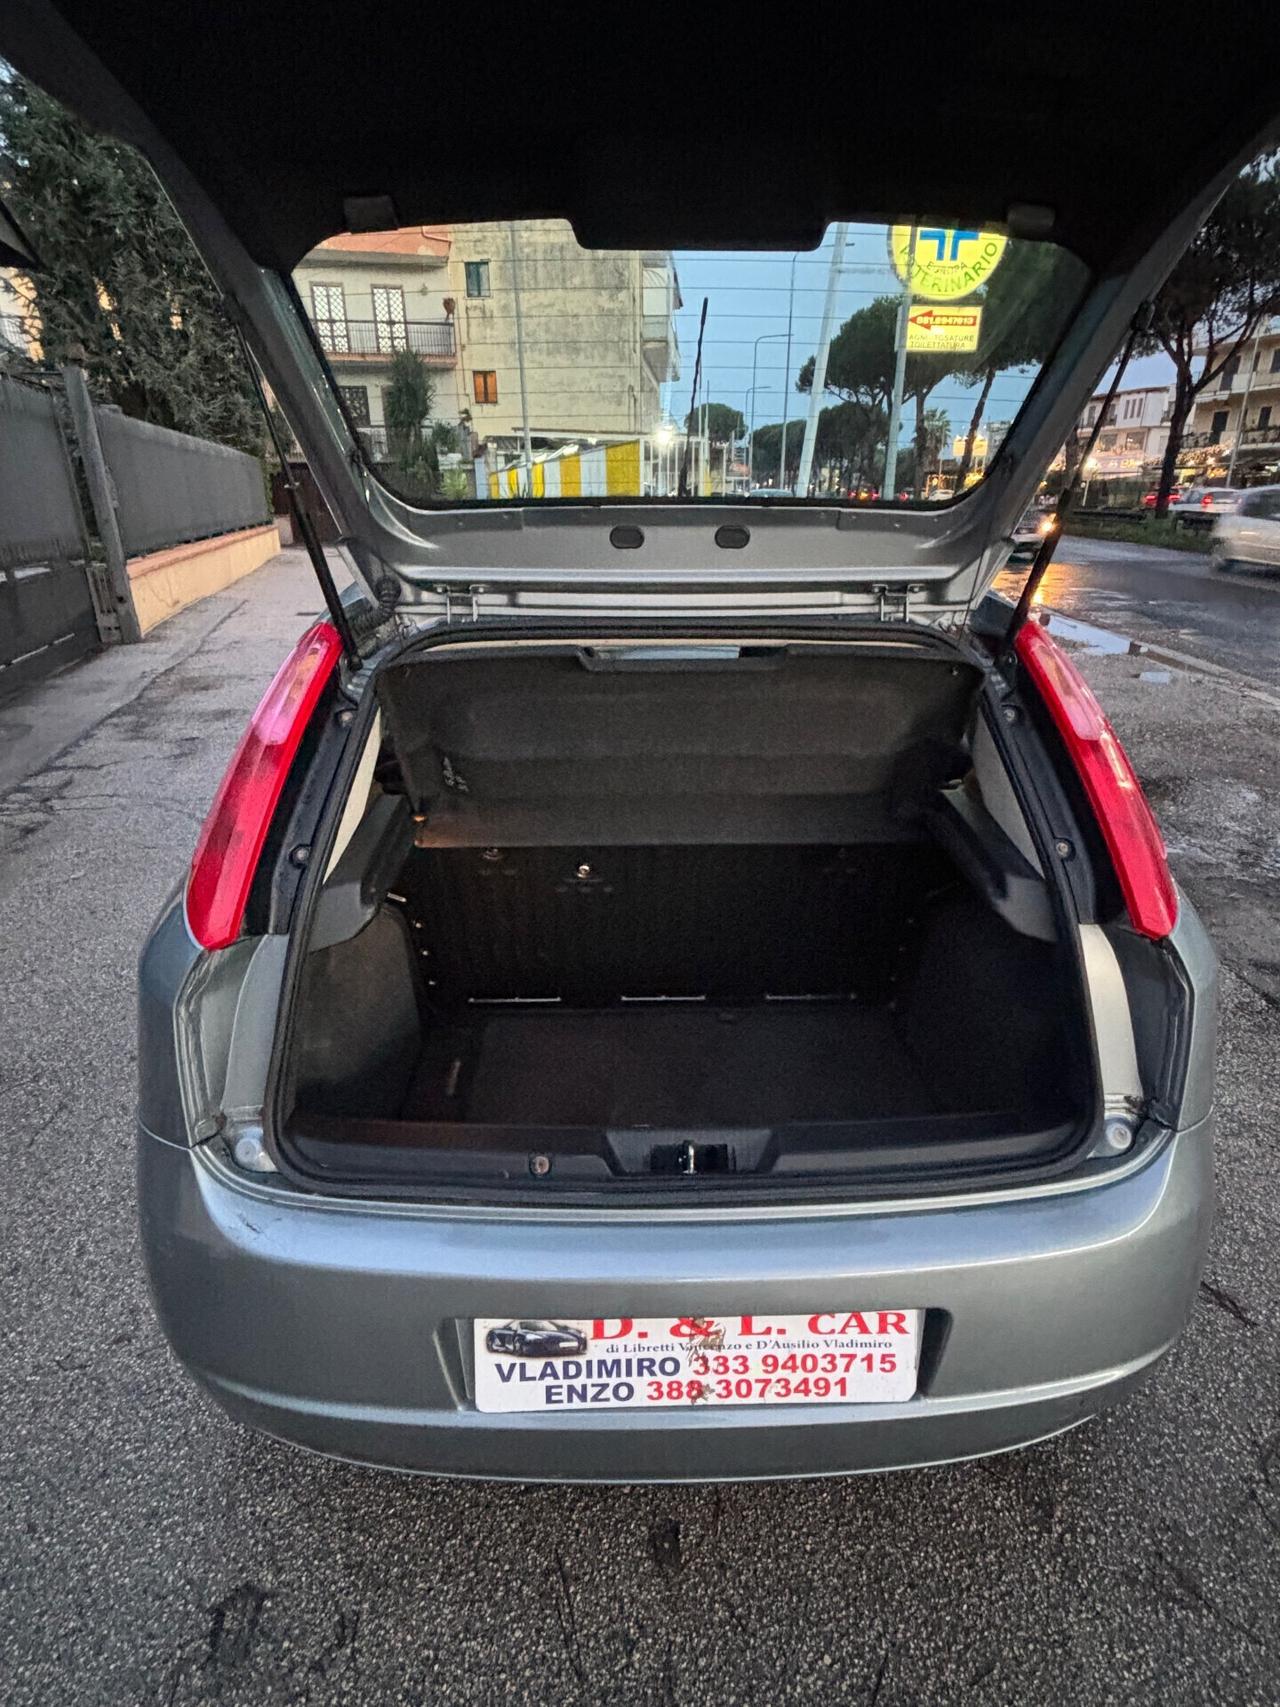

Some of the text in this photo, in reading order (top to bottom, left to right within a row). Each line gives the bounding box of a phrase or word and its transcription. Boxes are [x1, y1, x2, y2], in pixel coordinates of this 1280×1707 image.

[899, 242, 998, 293] VTERINARIO
[590, 1312, 910, 1340] D. & L. CAR
[606, 1343, 622, 1354] di
[623, 1341, 675, 1353] Libretti
[756, 1338, 820, 1349] D'Ausilio
[823, 1337, 892, 1349] Vladimiro
[495, 1353, 897, 1383] VLADIMIRO 333 9403715
[545, 1376, 847, 1405] ENZO 388 3073491
